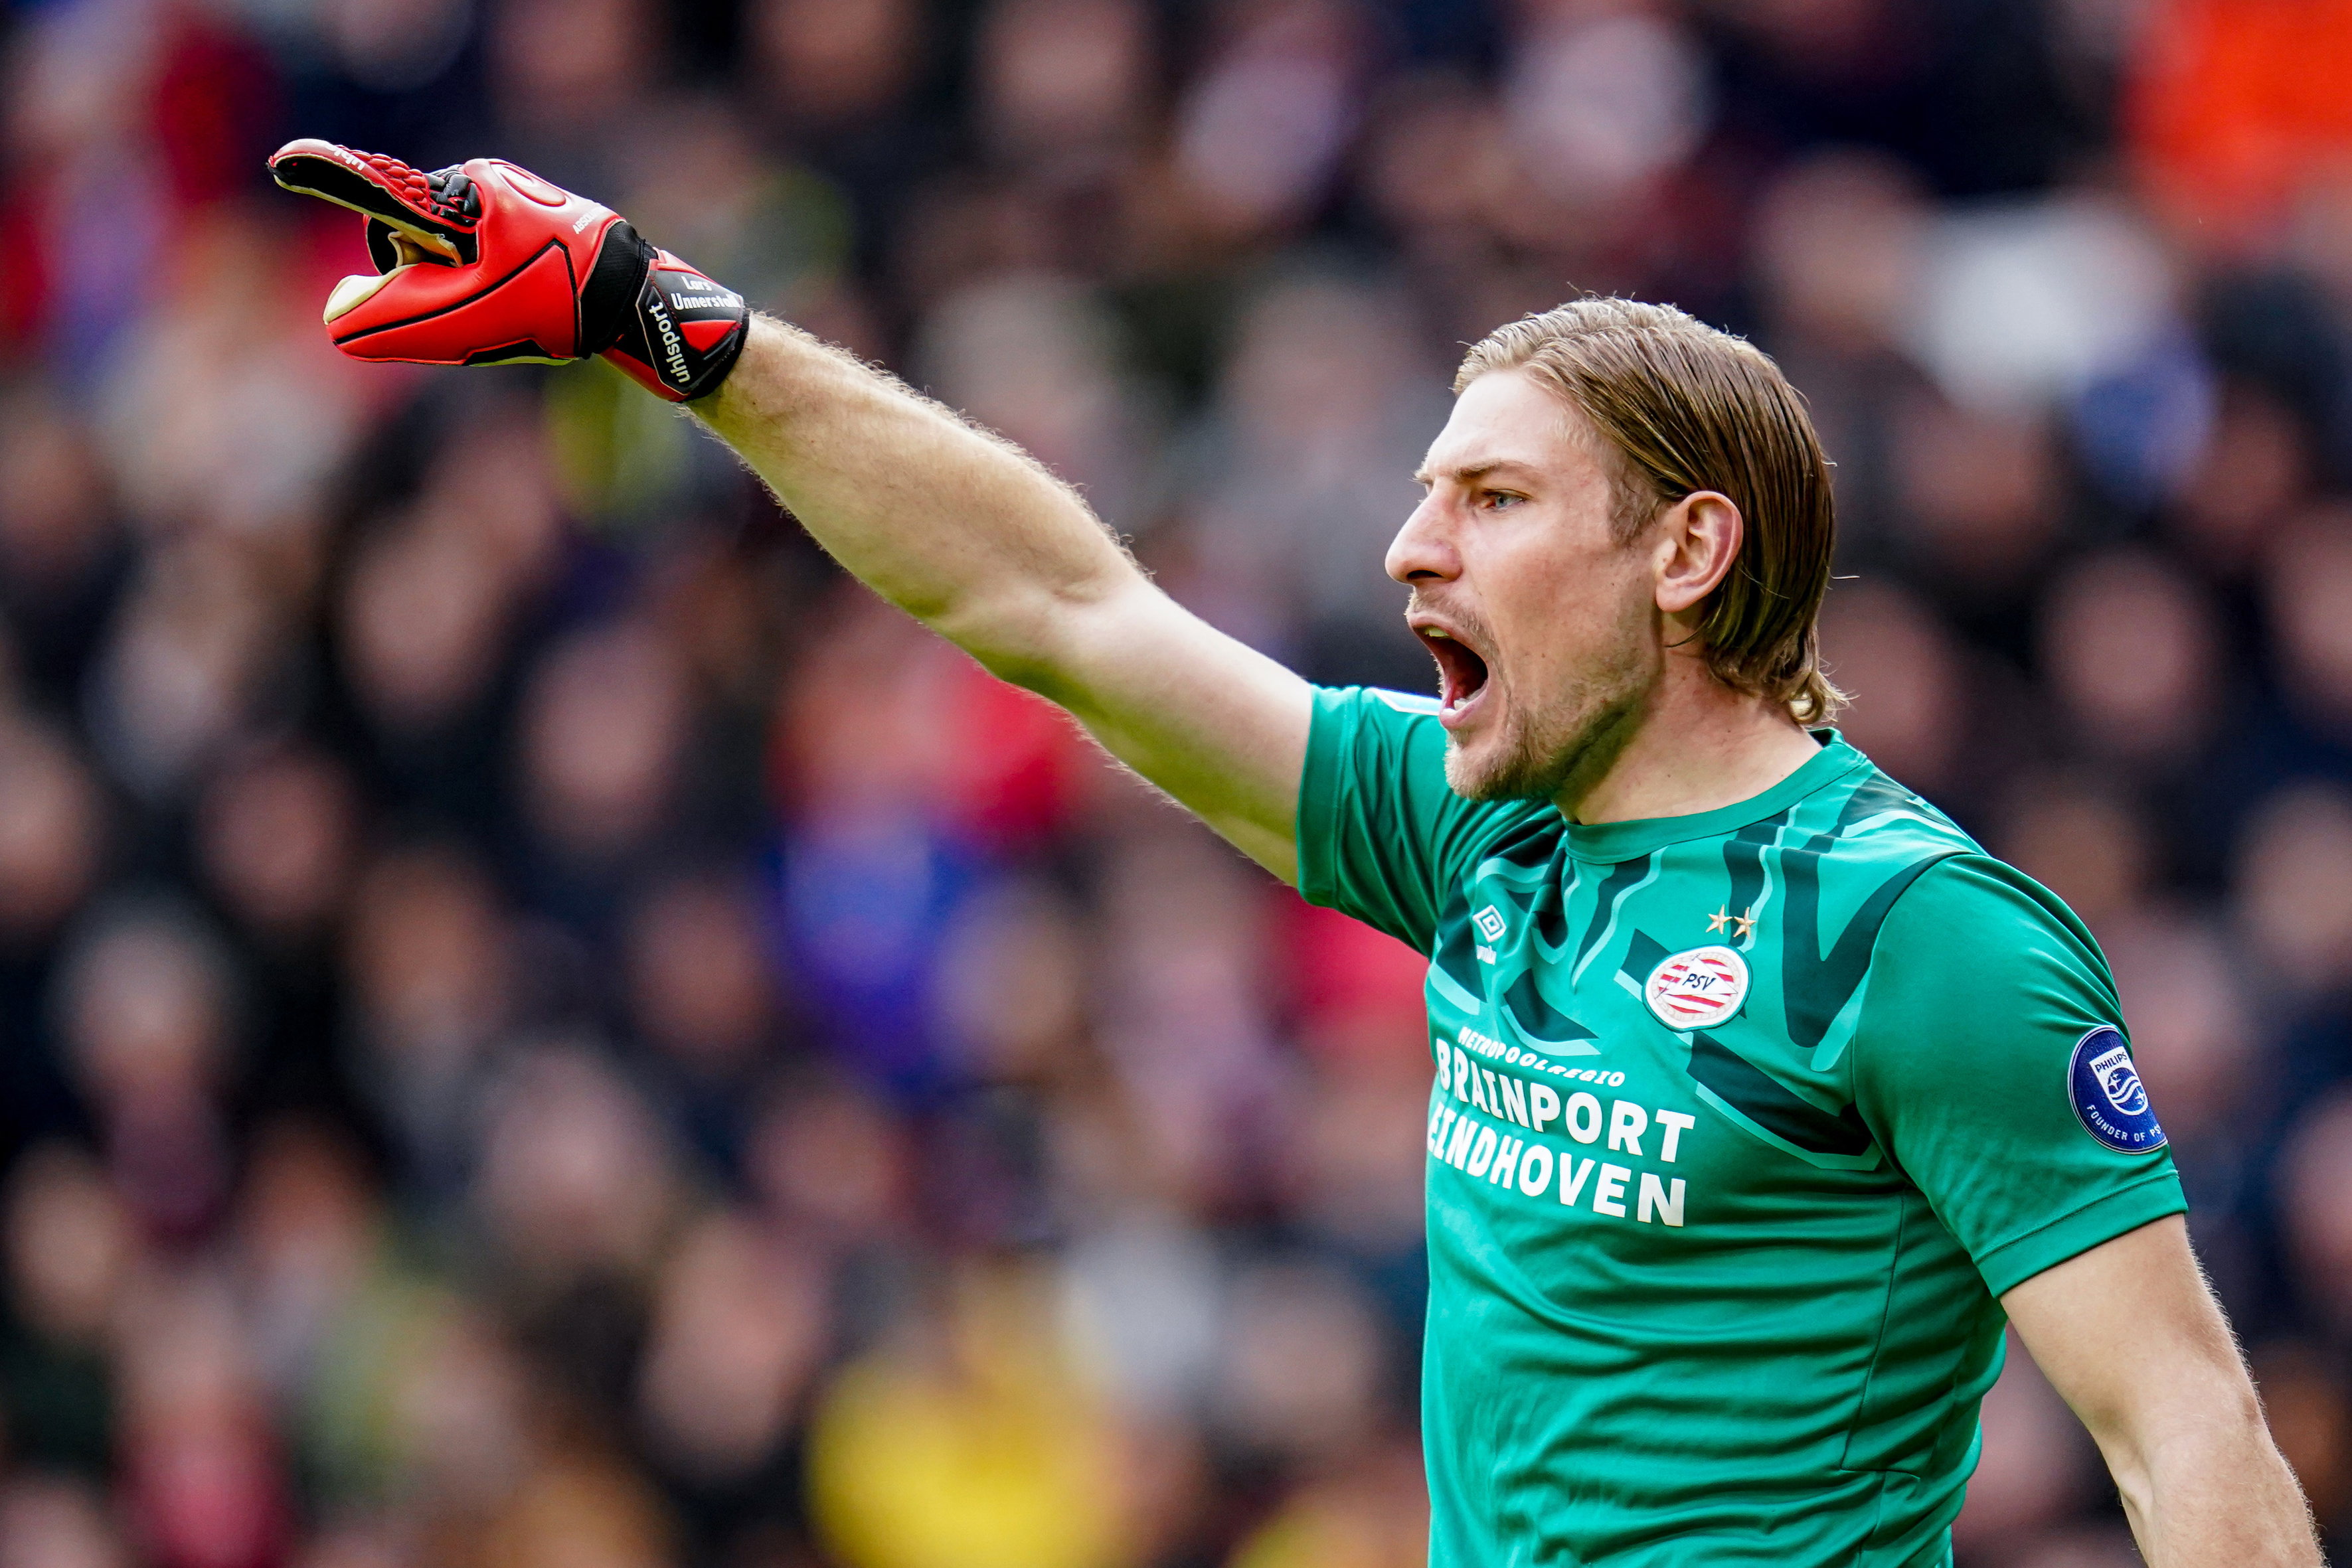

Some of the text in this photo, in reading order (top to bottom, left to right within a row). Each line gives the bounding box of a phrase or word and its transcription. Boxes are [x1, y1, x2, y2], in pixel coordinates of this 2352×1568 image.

[681, 275, 713, 291] Lars
[649, 302, 691, 383] uhlsport
[1682, 973, 1717, 990] PSV
[1458, 1026, 1626, 1087] METROPOOLREGIO
[2094, 1052, 2128, 1073] PHILIPS
[1436, 1038, 1695, 1163] BRAINPORT
[2086, 1105, 2161, 1142] FOUNDER OF PS
[1427, 1101, 1686, 1227] EINDHOVEN
